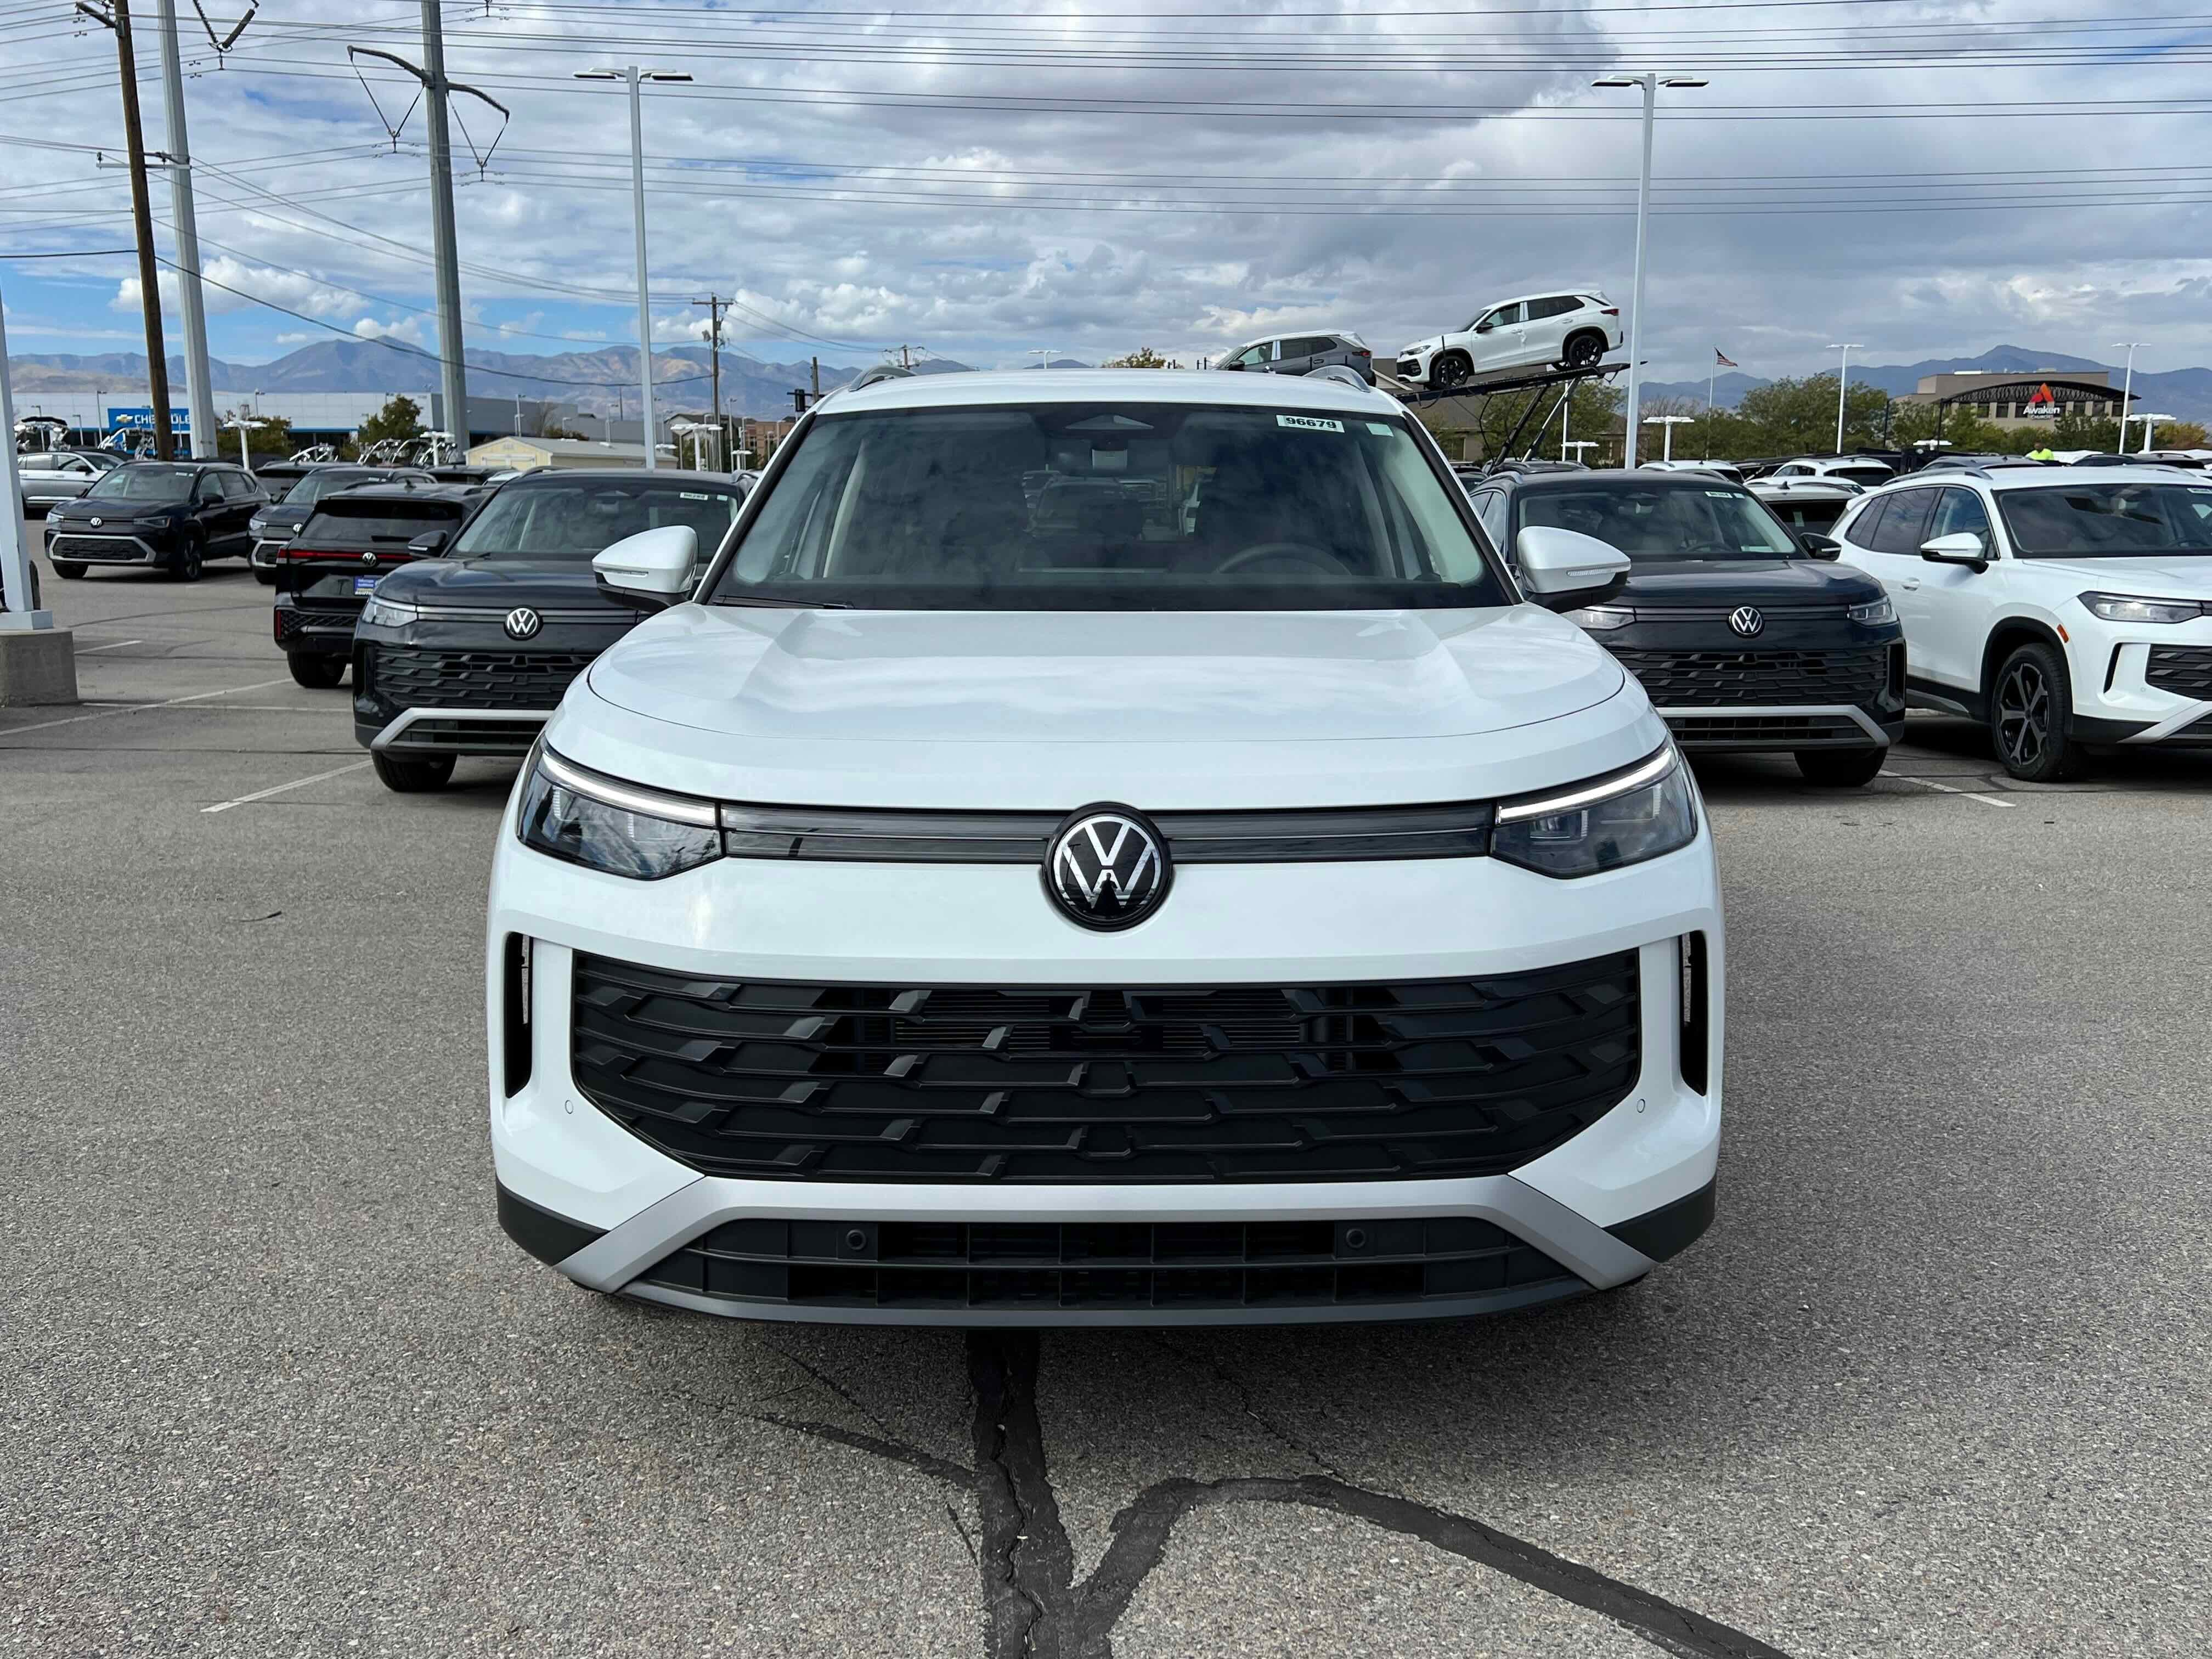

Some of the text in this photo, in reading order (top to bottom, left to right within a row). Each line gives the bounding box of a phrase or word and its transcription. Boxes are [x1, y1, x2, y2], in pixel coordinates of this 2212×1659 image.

[134, 414, 190, 424] CHEOLE
[2023, 405, 2061, 415] Awaken
[1285, 417, 1337, 428] 96679
[507, 608, 538, 636] VW
[1731, 606, 1762, 635] VW
[1054, 816, 1161, 920] VW
